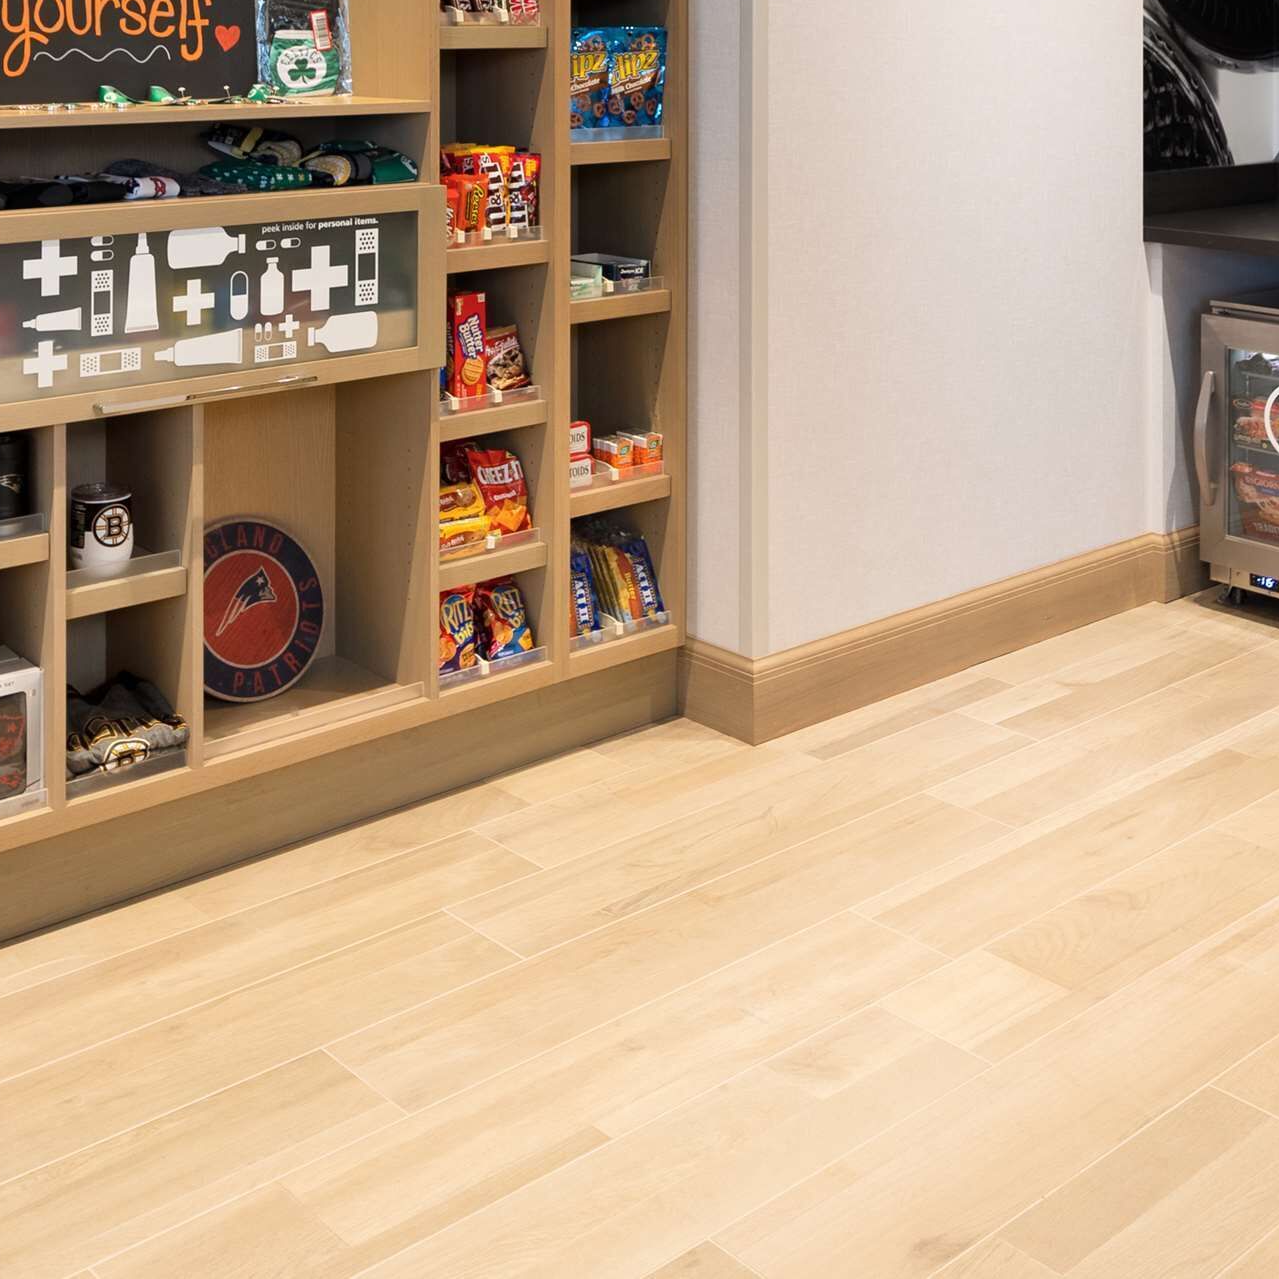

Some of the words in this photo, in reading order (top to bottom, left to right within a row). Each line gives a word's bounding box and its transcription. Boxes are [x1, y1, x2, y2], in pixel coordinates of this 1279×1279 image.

[261, 223, 281, 235] peek
[282, 221, 305, 232] inside
[305, 221, 318, 231] for
[318, 217, 353, 230] personal
[354, 216, 380, 226] items.
[232, 576, 321, 694] PATRIOTS
